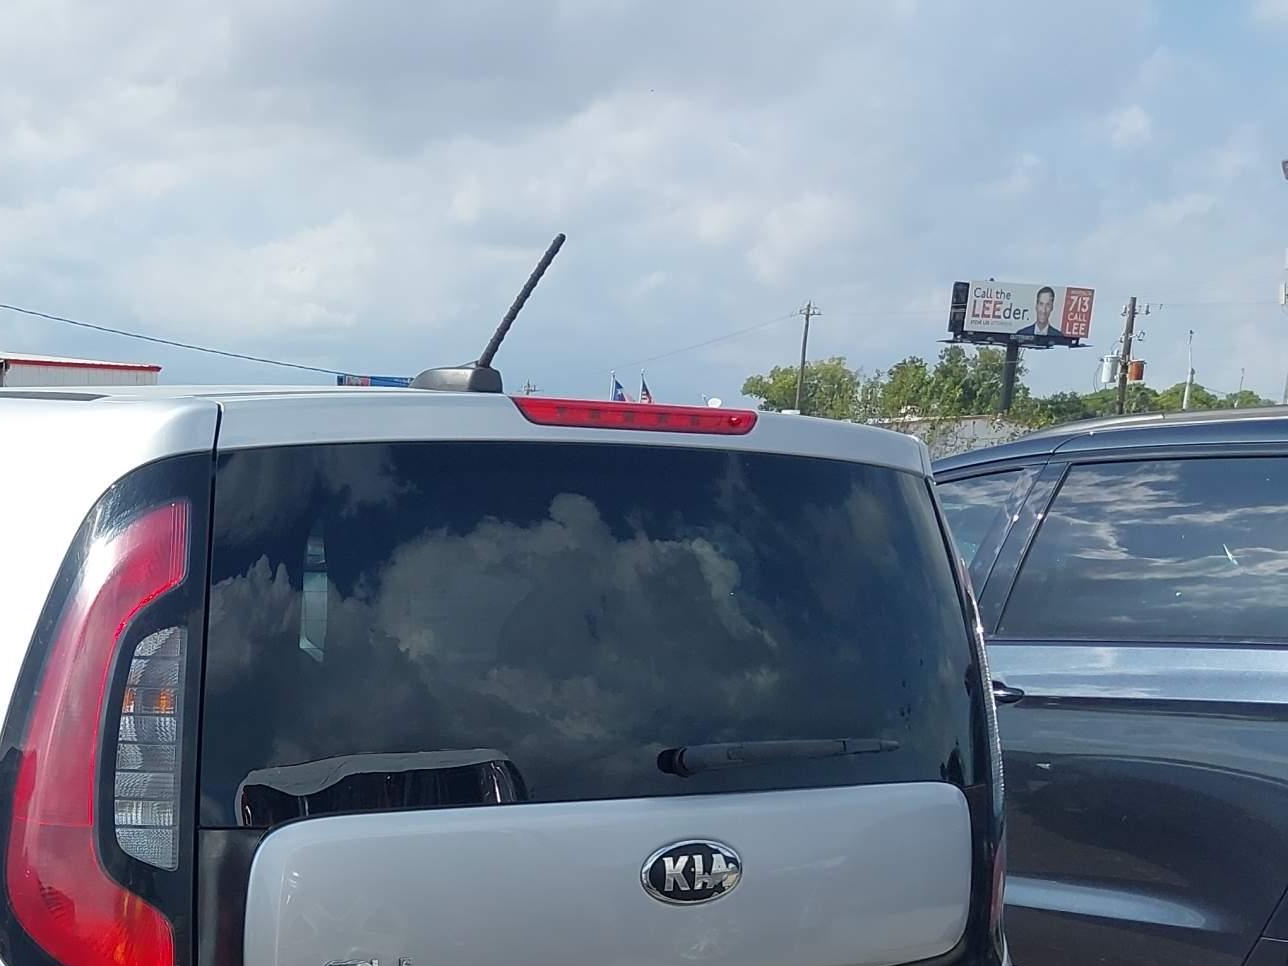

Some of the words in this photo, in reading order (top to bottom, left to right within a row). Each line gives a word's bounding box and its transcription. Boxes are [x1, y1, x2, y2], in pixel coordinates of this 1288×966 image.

[973, 287, 994, 299] Call
[996, 289, 1012, 301] the
[971, 299, 1030, 321] LEEder.
[1070, 296, 1090, 313] 713
[1067, 312, 1088, 322] CALL
[1065, 322, 1086, 336] LEE
[662, 853, 731, 893] KIA
